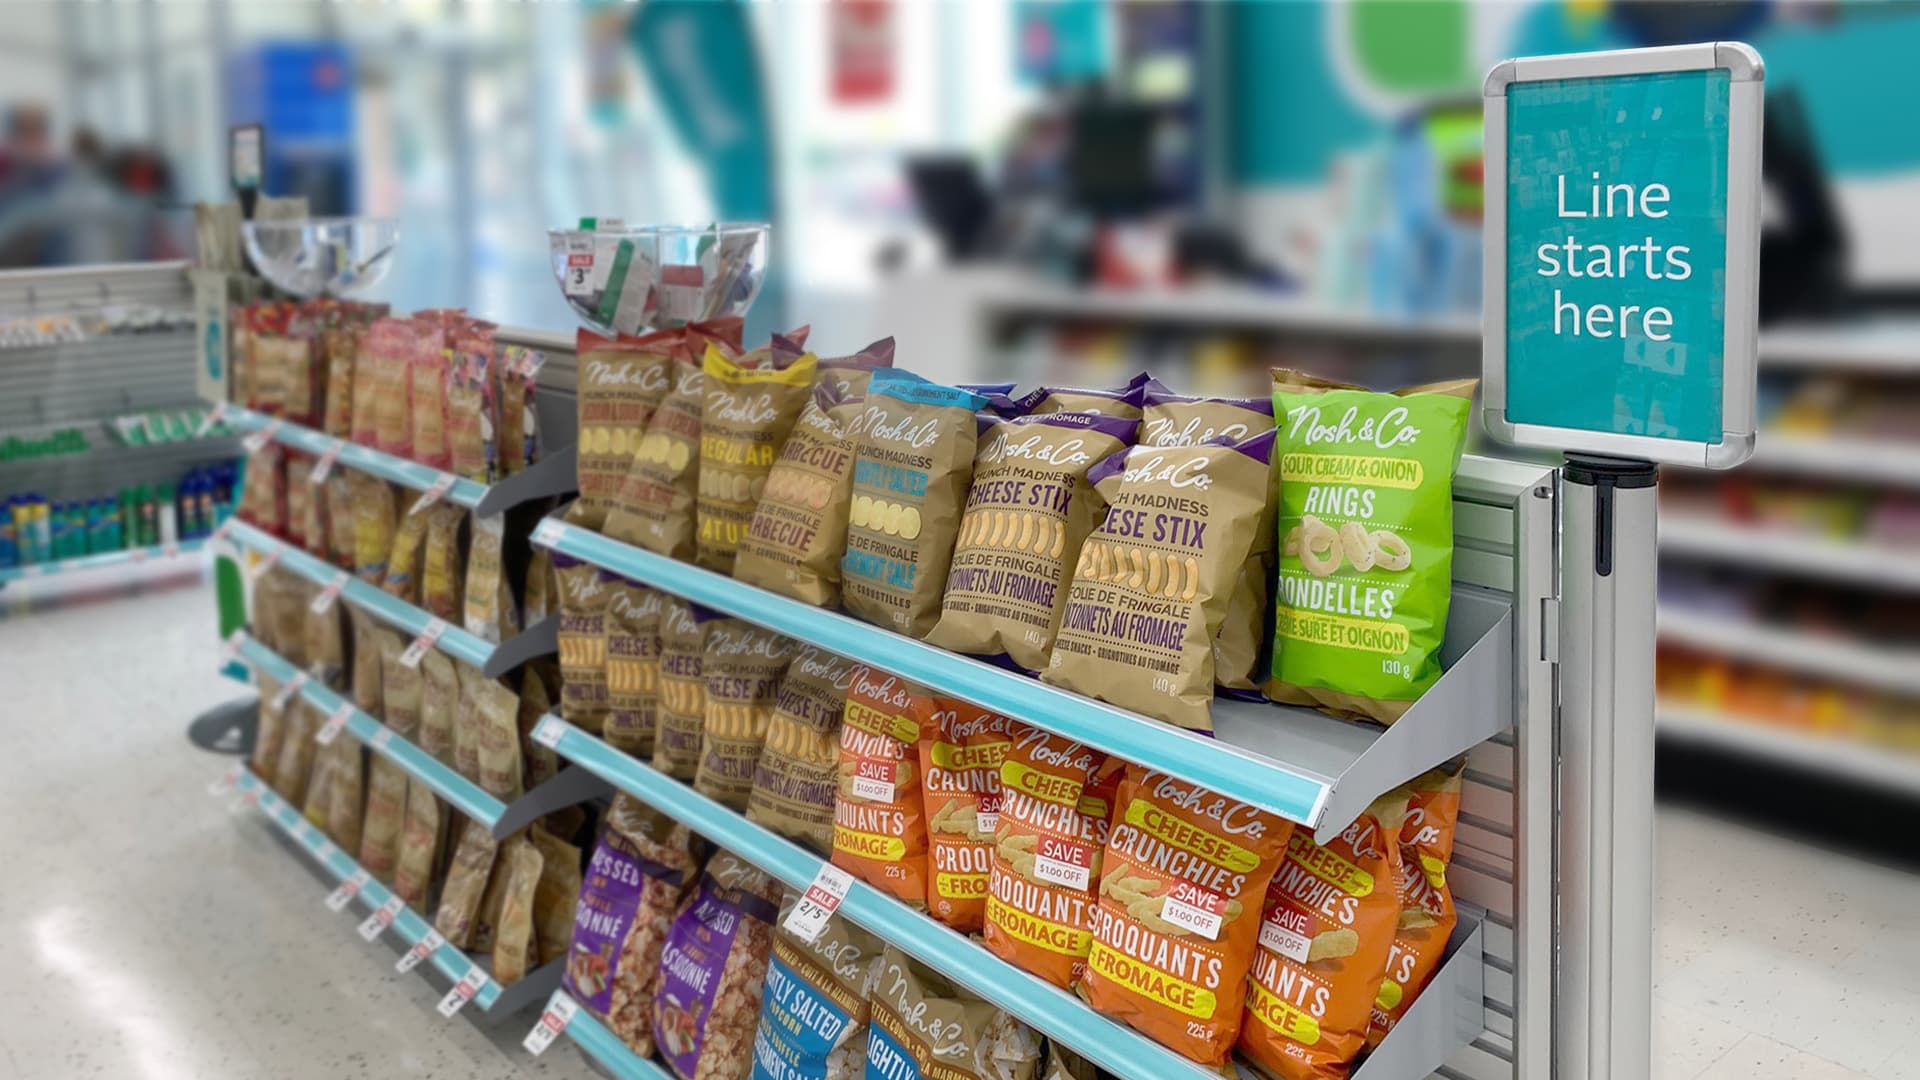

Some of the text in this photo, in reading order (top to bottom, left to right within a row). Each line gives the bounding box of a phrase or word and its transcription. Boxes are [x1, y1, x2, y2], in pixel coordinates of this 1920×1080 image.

[1558, 171, 1670, 218] Line
[1537, 235, 1692, 280] starts
[1554, 289, 1673, 341] here
[884, 448, 933, 470] MADNESS
[1282, 455, 1418, 482] SOUR CREAM & ONION
[1013, 466, 1076, 489] MADNESS
[968, 480, 1073, 516] CHEESE STIX
[1132, 493, 1209, 518] MADNESS
[1304, 486, 1376, 519] RINGS
[1152, 513, 1207, 549] STIX
[857, 536, 919, 563] DE FRINGALE
[976, 553, 993, 566] DE
[994, 555, 1061, 581] FRINGALE
[987, 570, 1005, 595] AU
[1003, 572, 1058, 608] FROMAGE
[1098, 590, 1117, 605] DE
[1119, 595, 1192, 620] FRINGALE
[1110, 610, 1130, 640] AU
[1128, 614, 1187, 652] FROMAGE
[1299, 619, 1328, 641] SURE
[1330, 622, 1345, 643] ET
[1347, 626, 1404, 651] OIGNON
[1138, 655, 1148, 668] AU
[1147, 657, 1181, 676] FROMAGE
[1382, 659, 1411, 680] 130 g
[1152, 677, 1169, 692] 140
[774, 758, 789, 772] DE
[859, 761, 890, 782] SAVE
[795, 780, 838, 808] FROMAGE
[856, 783, 890, 798] $1.00 OFF
[1143, 809, 1232, 862] CHEESE
[1043, 839, 1084, 865] SAVE
[1110, 824, 1246, 897] CRUNCHIES
[1288, 833, 1355, 882] CHEESE
[1040, 864, 1082, 883] $1.00 OFF
[810, 887, 836, 908] SALE
[989, 866, 1098, 929] CROQUANTS
[1174, 882, 1219, 912] SAVE
[993, 903, 1079, 951] FROMAGE
[1168, 906, 1214, 930] $1.00 OFF
[1271, 906, 1308, 935] SAVE
[1093, 908, 1223, 989] CROQUANTS
[1264, 930, 1303, 953] $1.00 OFF
[801, 962, 818, 981] CUIT
[822, 978, 832, 994] LA
[1096, 948, 1196, 1009] FROMAGE
[790, 989, 842, 1042] SALTED
[1186, 1021, 1205, 1038] 225
[1285, 1042, 1304, 1058] 225
